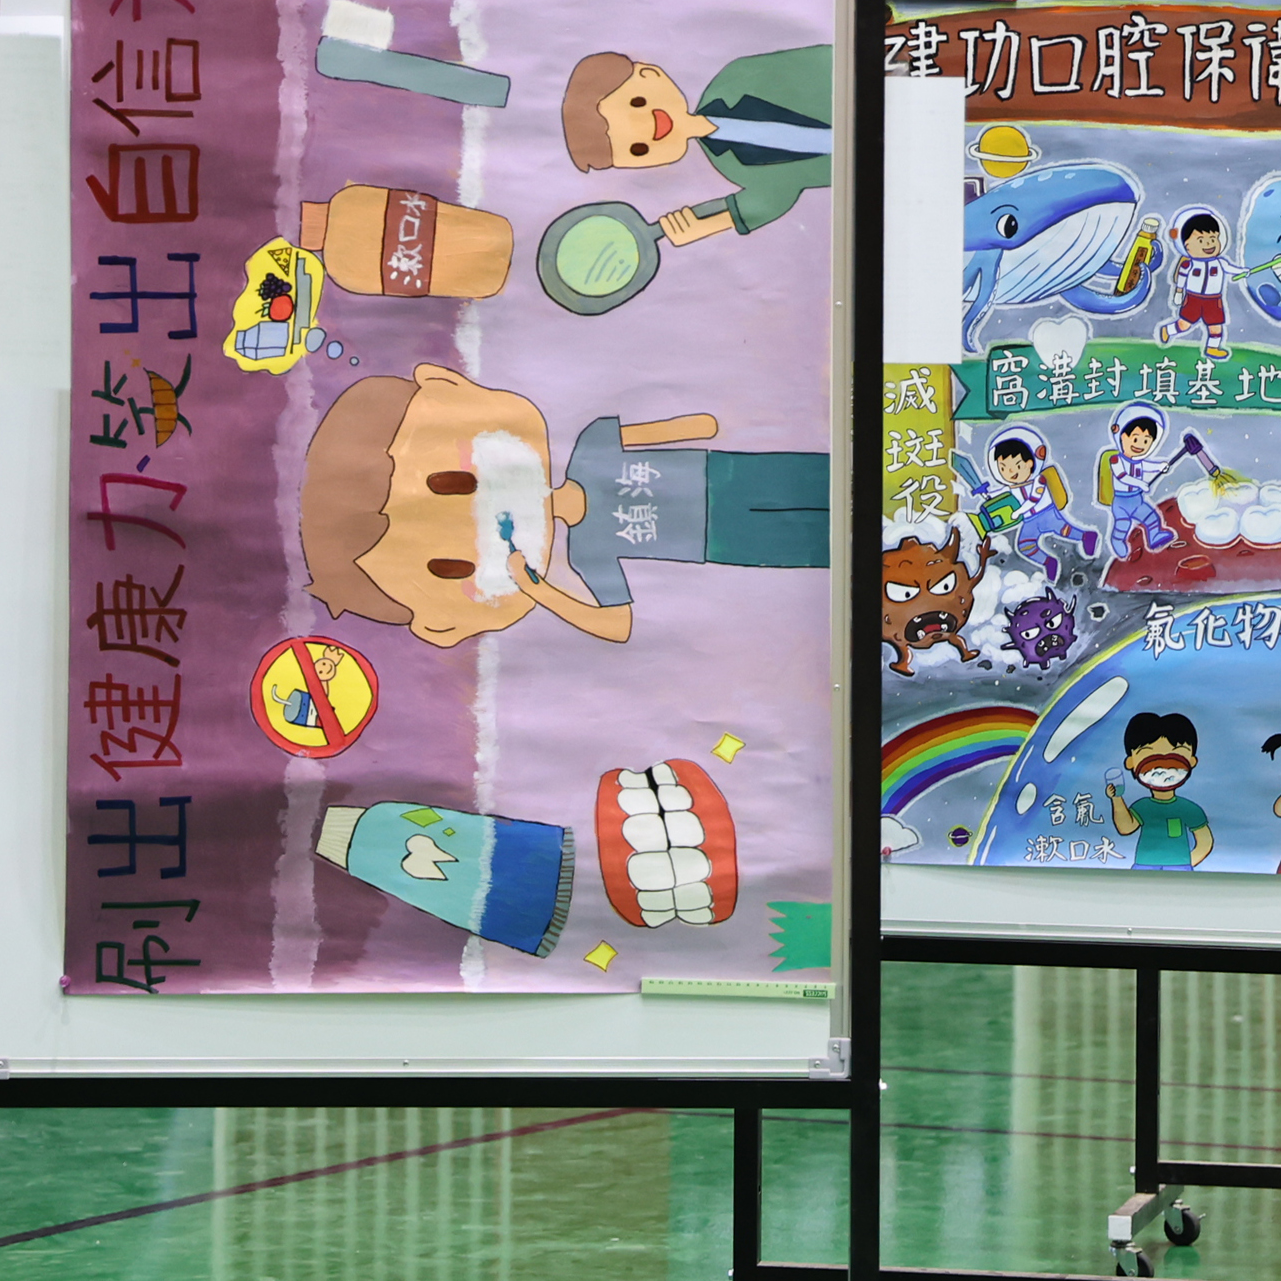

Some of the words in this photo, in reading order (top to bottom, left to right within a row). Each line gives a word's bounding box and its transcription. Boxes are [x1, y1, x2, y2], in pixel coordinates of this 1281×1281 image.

[385, 191, 428, 290] 漱口水
[613, 459, 662, 545] 鎮海
[1044, 793, 1104, 826] 含氟
[1024, 836, 1124, 864] 漱口水
